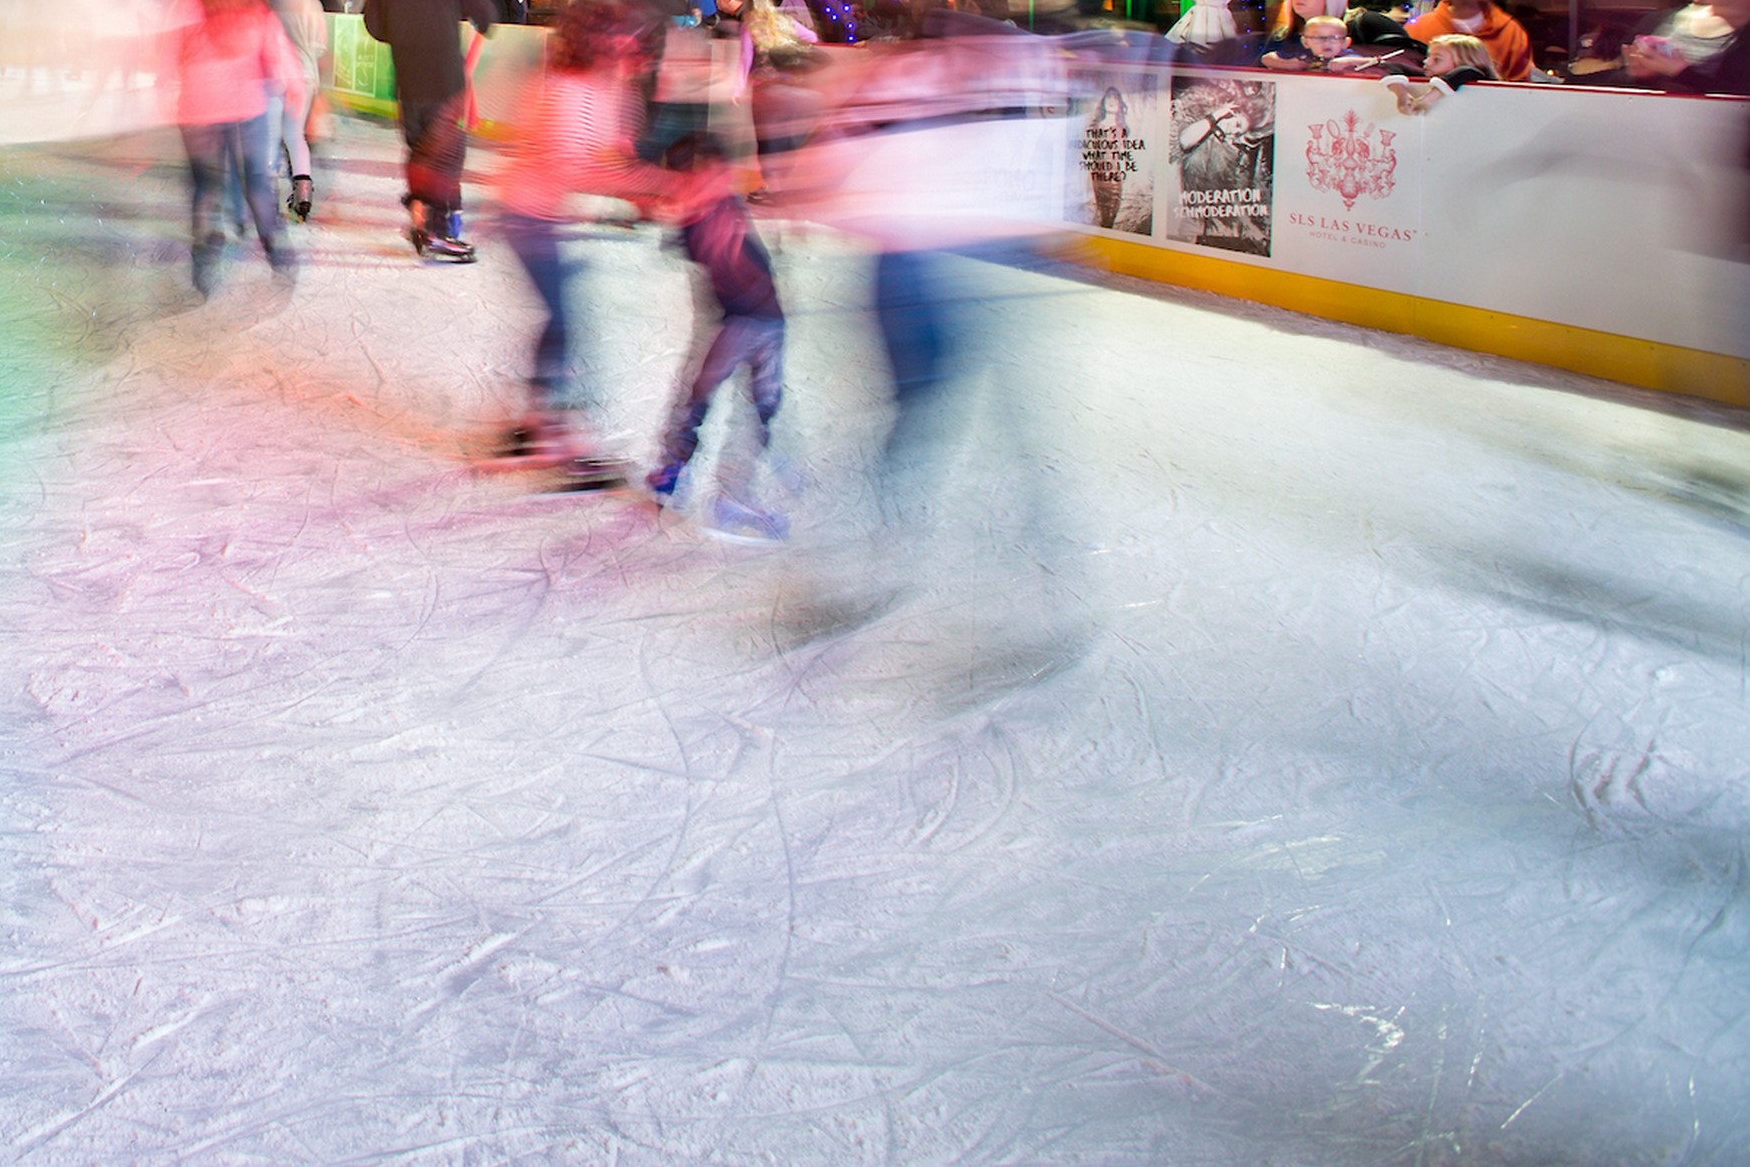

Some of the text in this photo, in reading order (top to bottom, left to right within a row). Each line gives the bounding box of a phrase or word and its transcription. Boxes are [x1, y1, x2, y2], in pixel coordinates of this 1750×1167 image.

[1086, 126, 1129, 139] THAT'S A
[1122, 139, 1146, 150] IDEA
[1082, 150, 1134, 161] WHAT TIME
[1079, 160, 1138, 172] SHOULD I BE
[1090, 171, 1127, 182] THERE?
[1179, 188, 1261, 205] MODERATION
[1173, 203, 1269, 219] SCHMODERATION
[1289, 212, 1412, 242] SLS LAS VEGAS
[1309, 231, 1386, 249] HOTEL & CASINO
